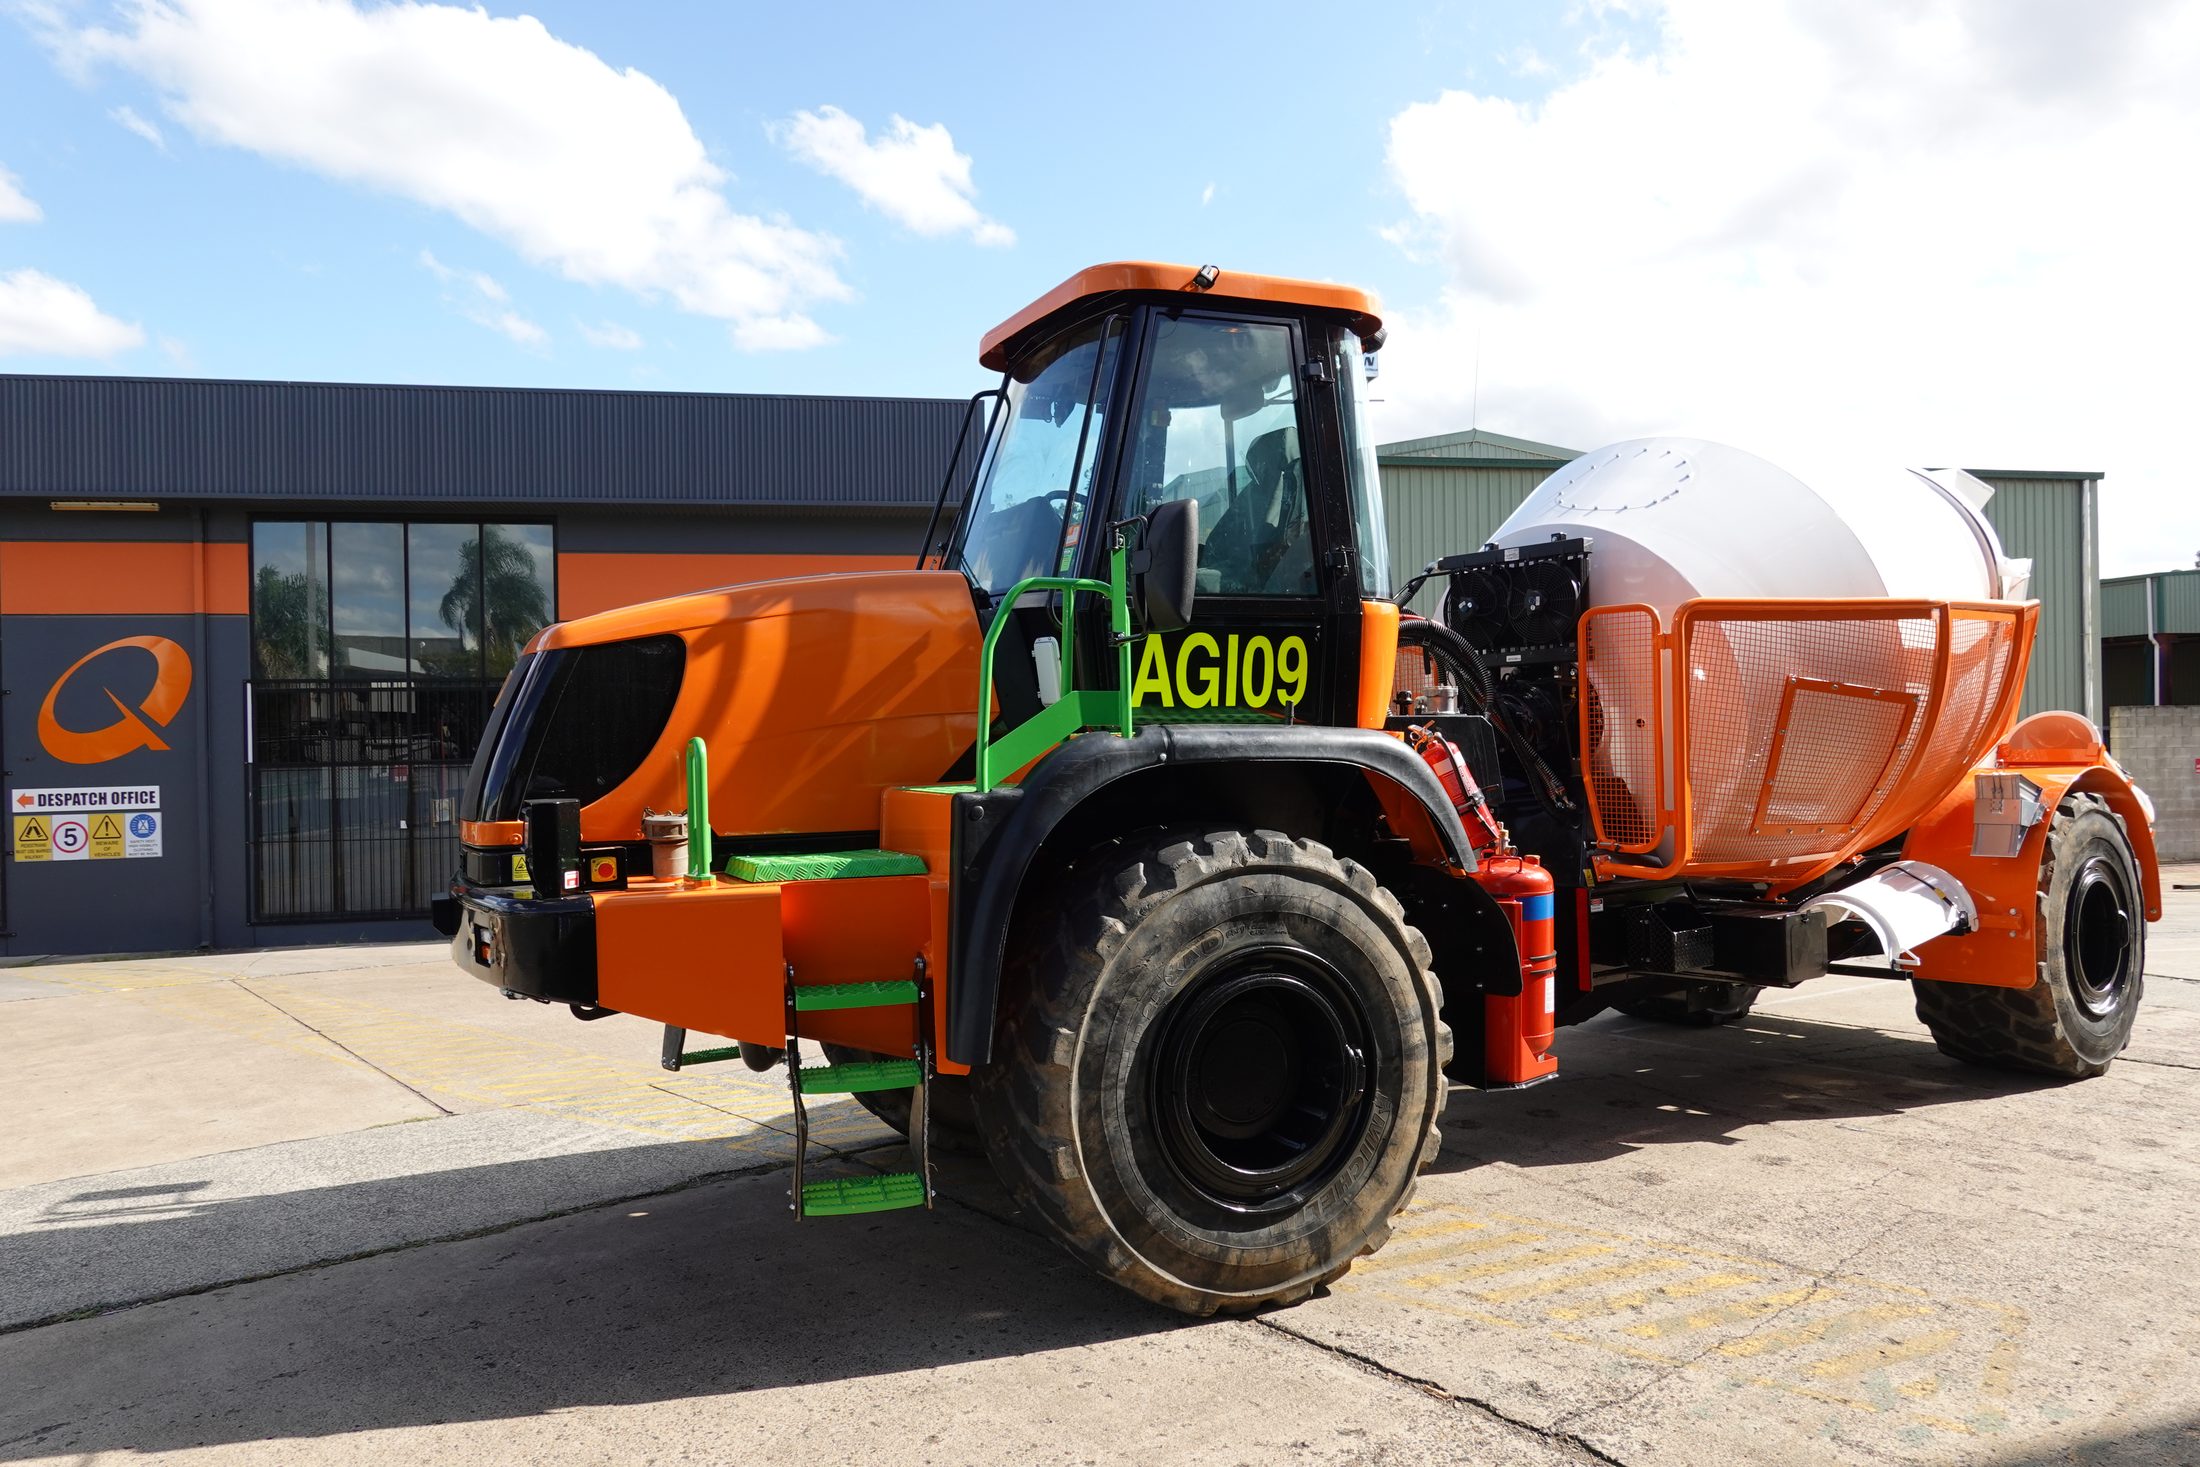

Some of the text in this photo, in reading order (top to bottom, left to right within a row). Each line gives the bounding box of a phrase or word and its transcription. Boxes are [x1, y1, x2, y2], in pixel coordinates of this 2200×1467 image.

[1131, 632, 1308, 708] AGI09
[38, 791, 156, 807] DESPATCH OFFICE
[63, 828, 78, 847] 5
